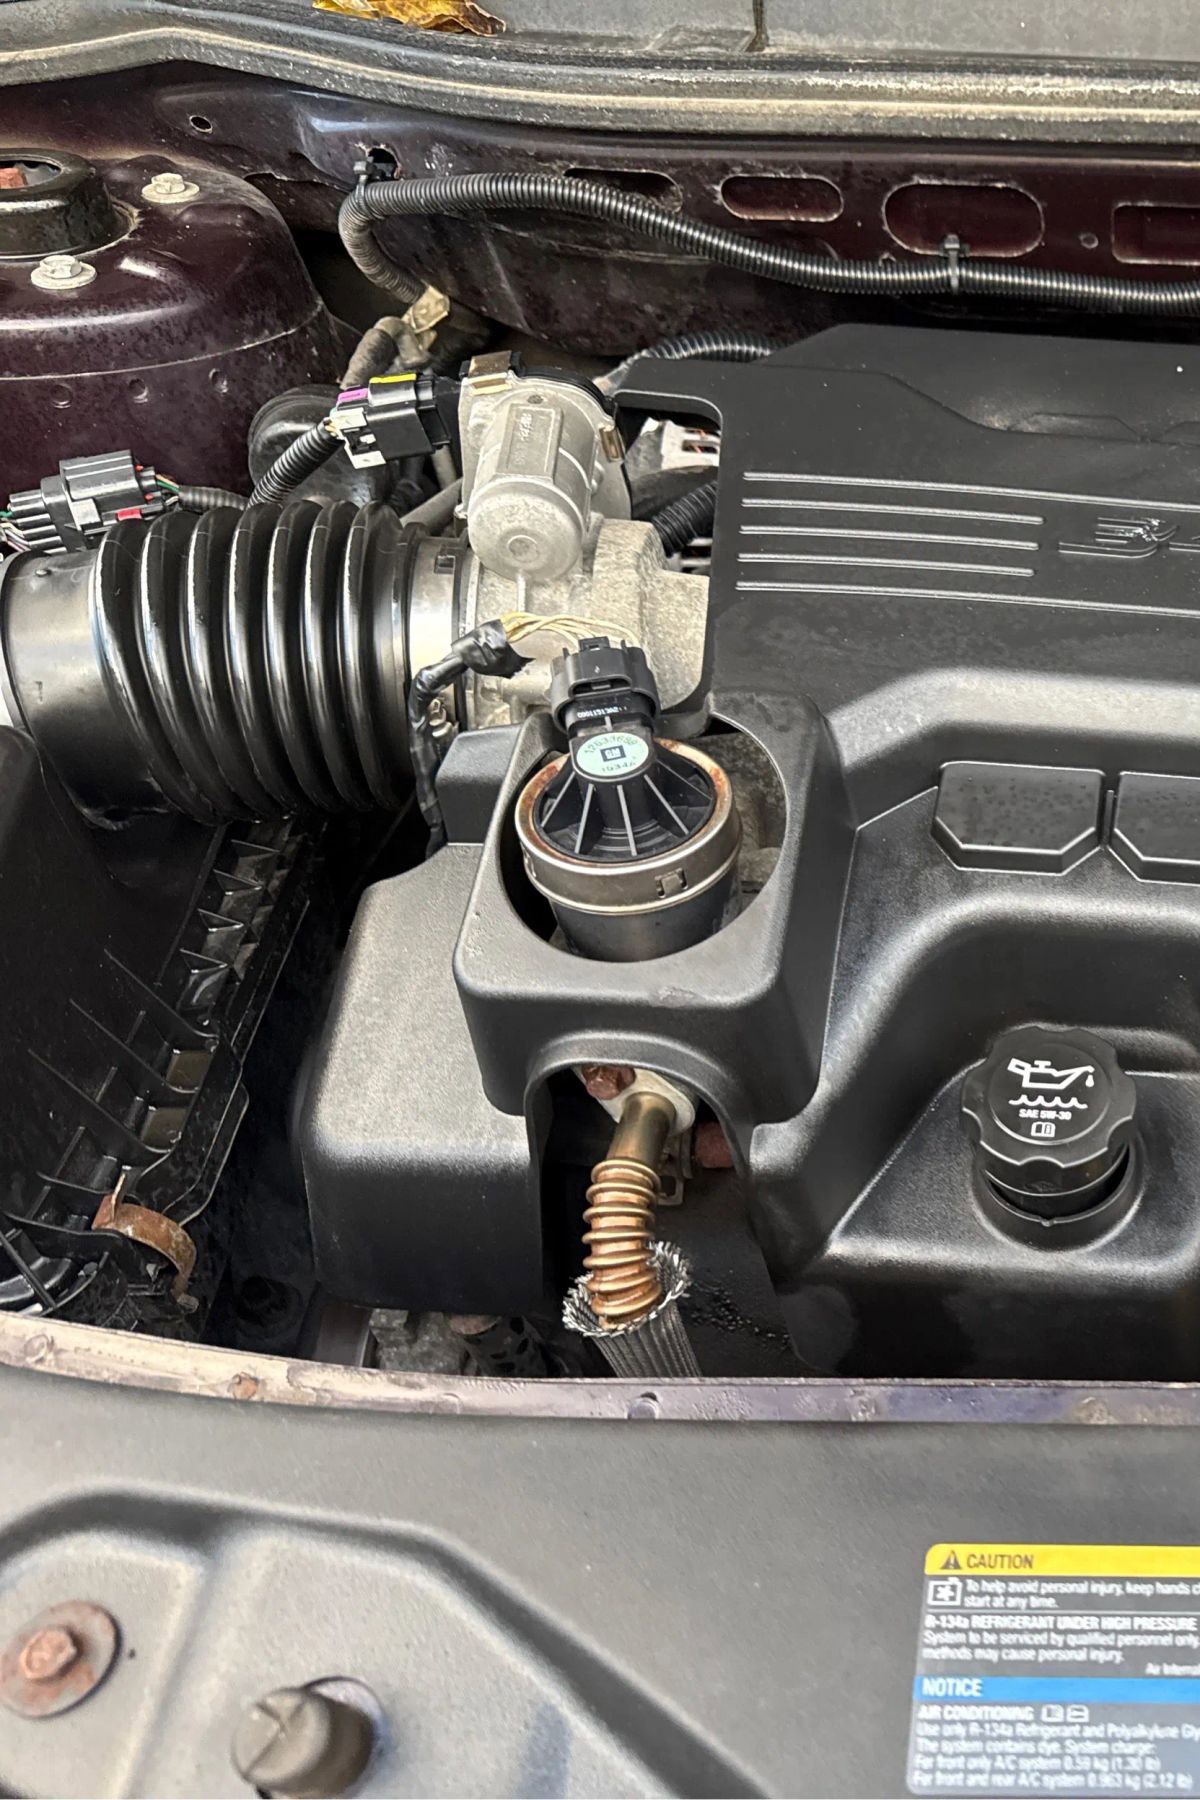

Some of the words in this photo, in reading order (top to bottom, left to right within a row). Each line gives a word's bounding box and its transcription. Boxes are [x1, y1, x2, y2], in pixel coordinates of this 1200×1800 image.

[1018, 1108, 1039, 1118] SAE
[1040, 1110, 1072, 1120] 5W-30
[967, 1554, 1034, 1569] CAUTION
[965, 1579, 980, 1592] To
[980, 1579, 1007, 1593] help
[1007, 1580, 1039, 1593] avoid
[1039, 1580, 1089, 1594] personal
[1124, 1581, 1154, 1595] keep
[1155, 1582, 1190, 1594] hands
[963, 1595, 991, 1607] start
[991, 1596, 1005, 1607] at
[1005, 1596, 1028, 1609] any
[923, 1614, 970, 1628] R-134a
[970, 1615, 1055, 1629] REFRIGERANT
[1056, 1616, 1099, 1629] UNDER
[1101, 1616, 1131, 1630] HIGH
[1132, 1617, 1197, 1630] PRESSURE
[921, 1630, 967, 1645] System
[967, 1631, 981, 1644] to
[981, 1631, 998, 1644] be
[999, 1631, 1048, 1644] serviced
[1049, 1631, 1065, 1646] by
[1064, 1632, 1115, 1647] qualified
[1116, 1633, 1173, 1647] personnel
[973, 1648, 1000, 1662] may
[1000, 1649, 1036, 1660] cause
[1037, 1647, 1087, 1662] personal
[922, 1678, 983, 1697] NOTICE
[916, 1705, 942, 1719] AIR
[942, 1705, 1034, 1720] CONDITIONING
[940, 1722, 967, 1739] only
[1081, 1723, 1105, 1740] and
[939, 1739, 983, 1755] system
[1063, 1740, 1109, 1755] System
